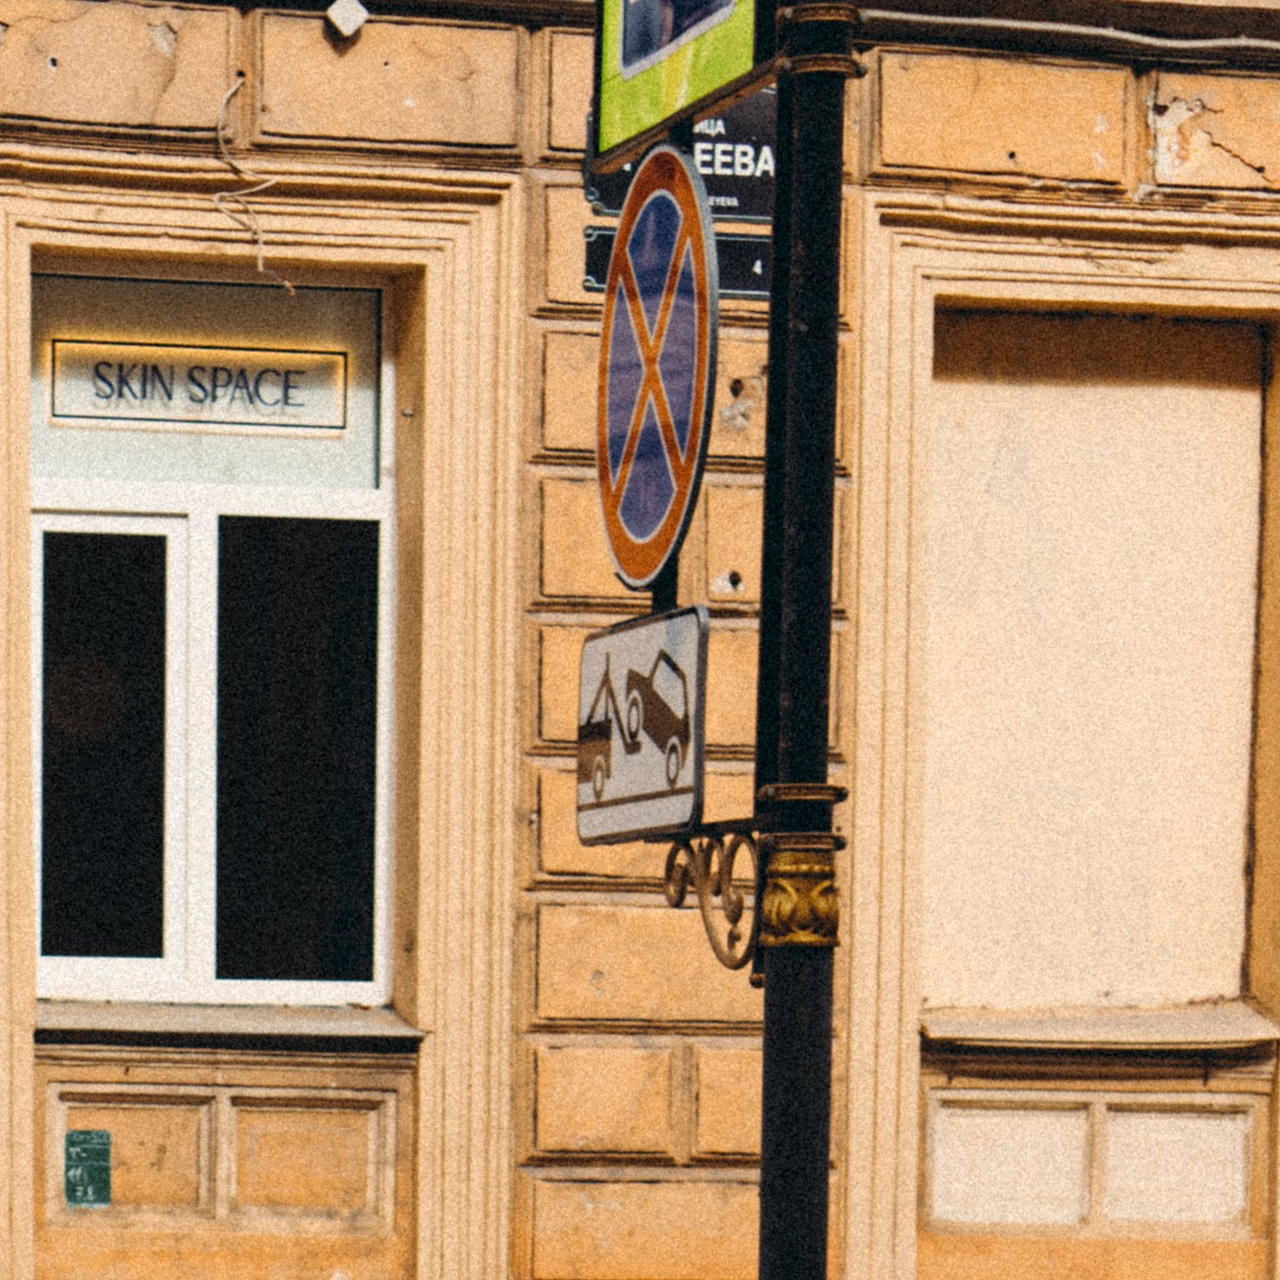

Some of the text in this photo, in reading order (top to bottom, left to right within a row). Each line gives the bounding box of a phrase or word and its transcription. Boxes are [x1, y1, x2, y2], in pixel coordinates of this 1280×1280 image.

[752, 259, 763, 275] 4
[93, 361, 307, 407] SKIN SPACE
